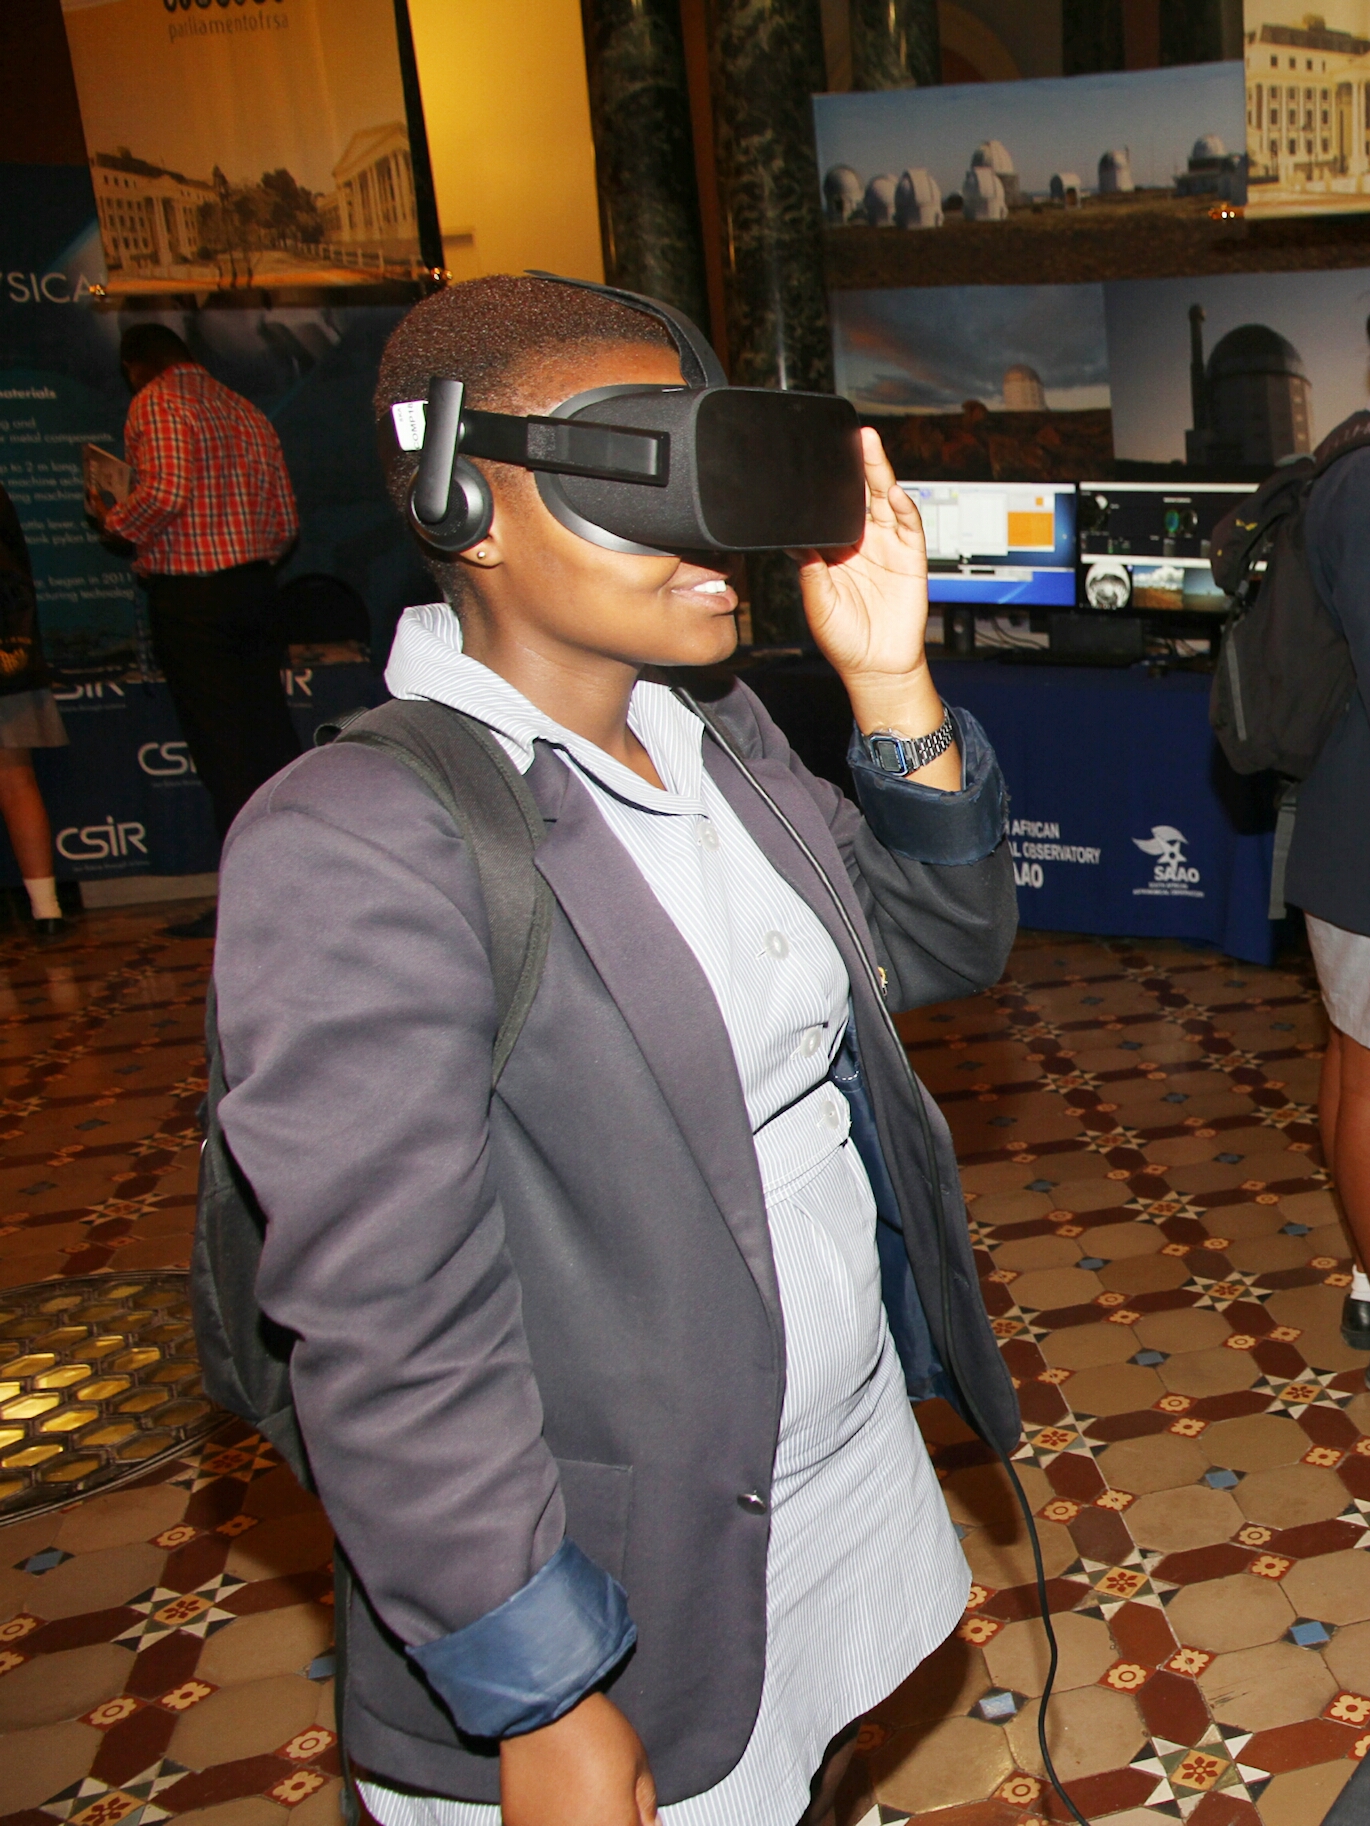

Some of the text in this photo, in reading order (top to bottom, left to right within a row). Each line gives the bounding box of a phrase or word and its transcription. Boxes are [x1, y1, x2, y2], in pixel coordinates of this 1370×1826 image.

[56, 815, 150, 861] CSIR
[1012, 819, 1060, 839] AFRICAN
[1022, 841, 1101, 865] OBSERVATORY
[1154, 865, 1200, 883] SAAO
